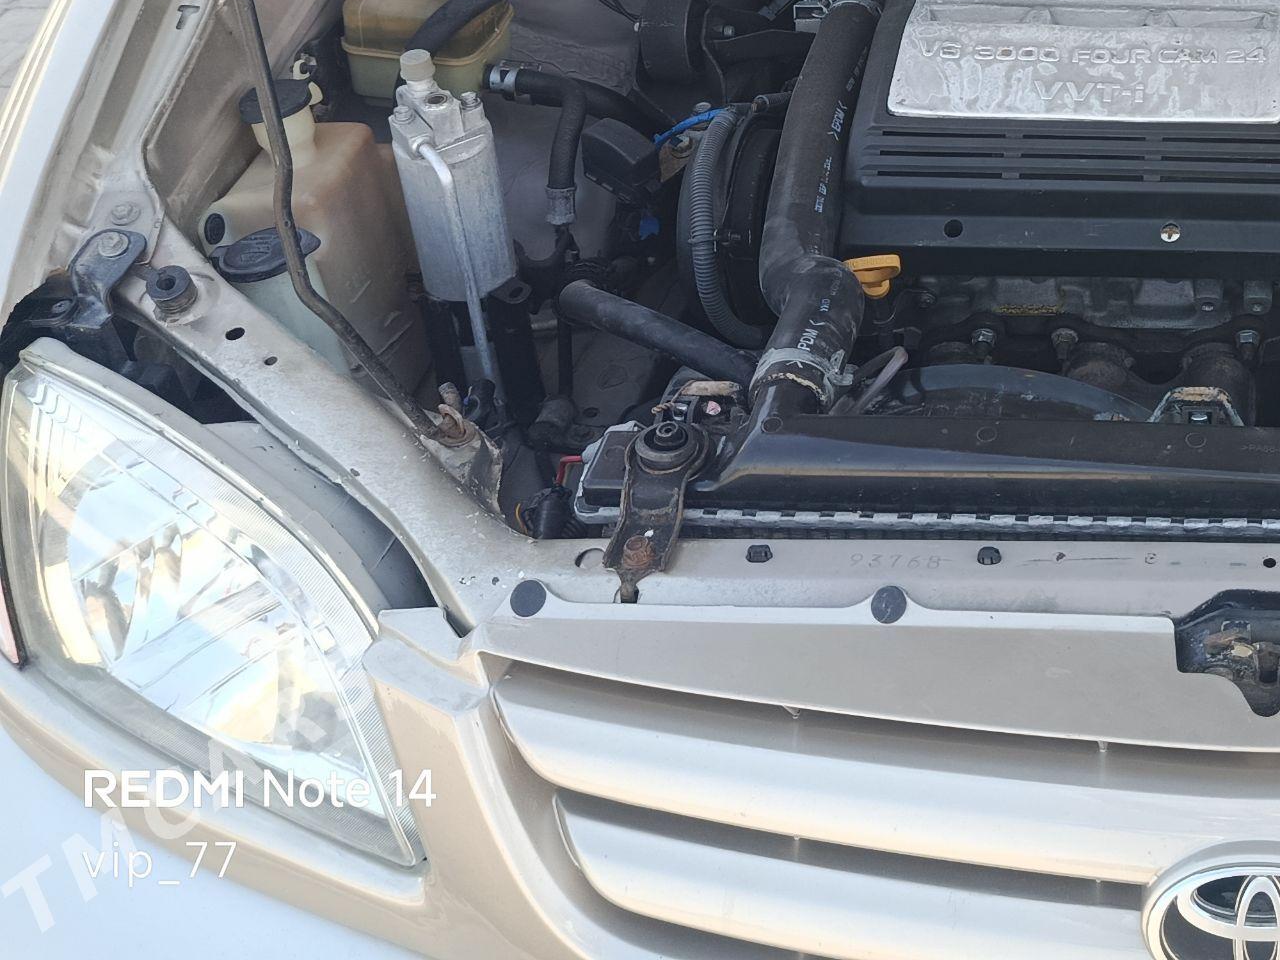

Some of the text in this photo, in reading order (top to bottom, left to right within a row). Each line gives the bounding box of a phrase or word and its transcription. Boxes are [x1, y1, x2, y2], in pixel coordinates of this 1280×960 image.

[973, 43, 1060, 63] 3000
[1072, 47, 1152, 65] FOUR
[1157, 47, 1219, 64] CAM
[1223, 46, 1267, 64] 24
[1033, 80, 1146, 104] VVT-i
